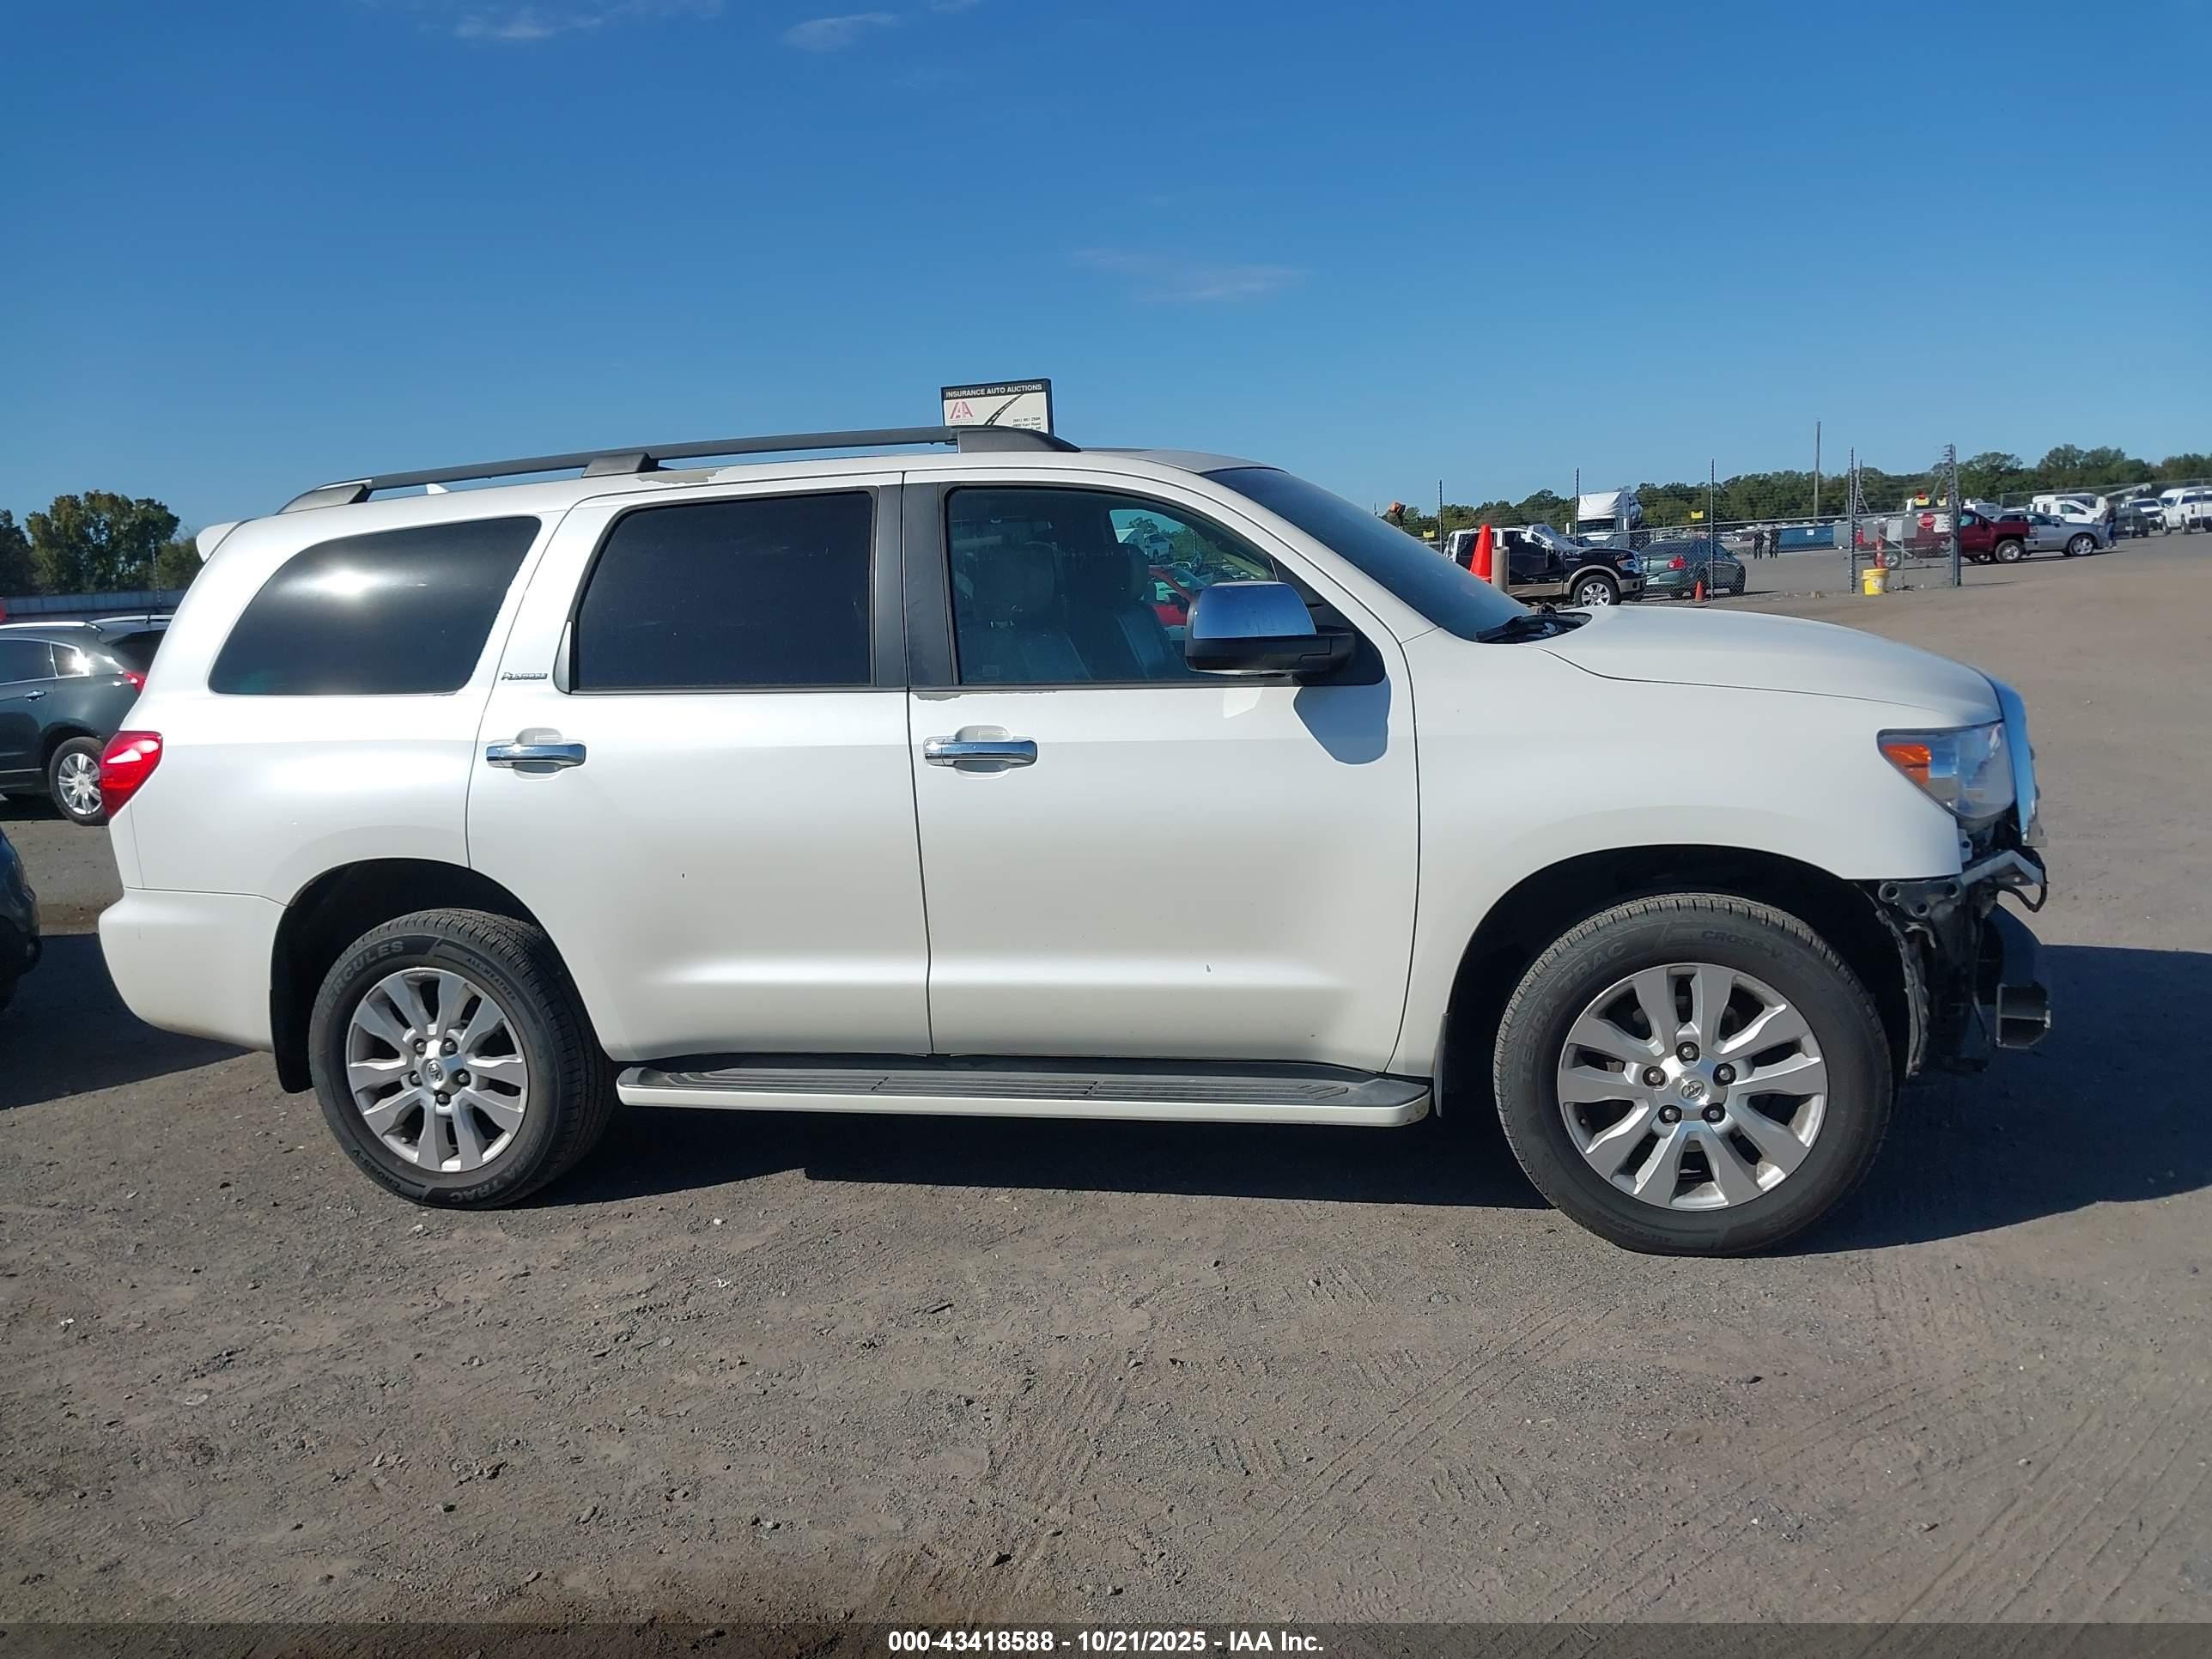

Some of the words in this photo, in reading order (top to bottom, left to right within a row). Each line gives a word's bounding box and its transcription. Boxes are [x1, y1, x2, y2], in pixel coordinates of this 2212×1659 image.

[945, 389, 986, 398] INSURANCE
[987, 386, 1006, 395] AUTO
[1006, 383, 1042, 392] AUCTIONS
[1557, 942, 1626, 992] TRAC
[449, 1179, 505, 1203] TRAC
